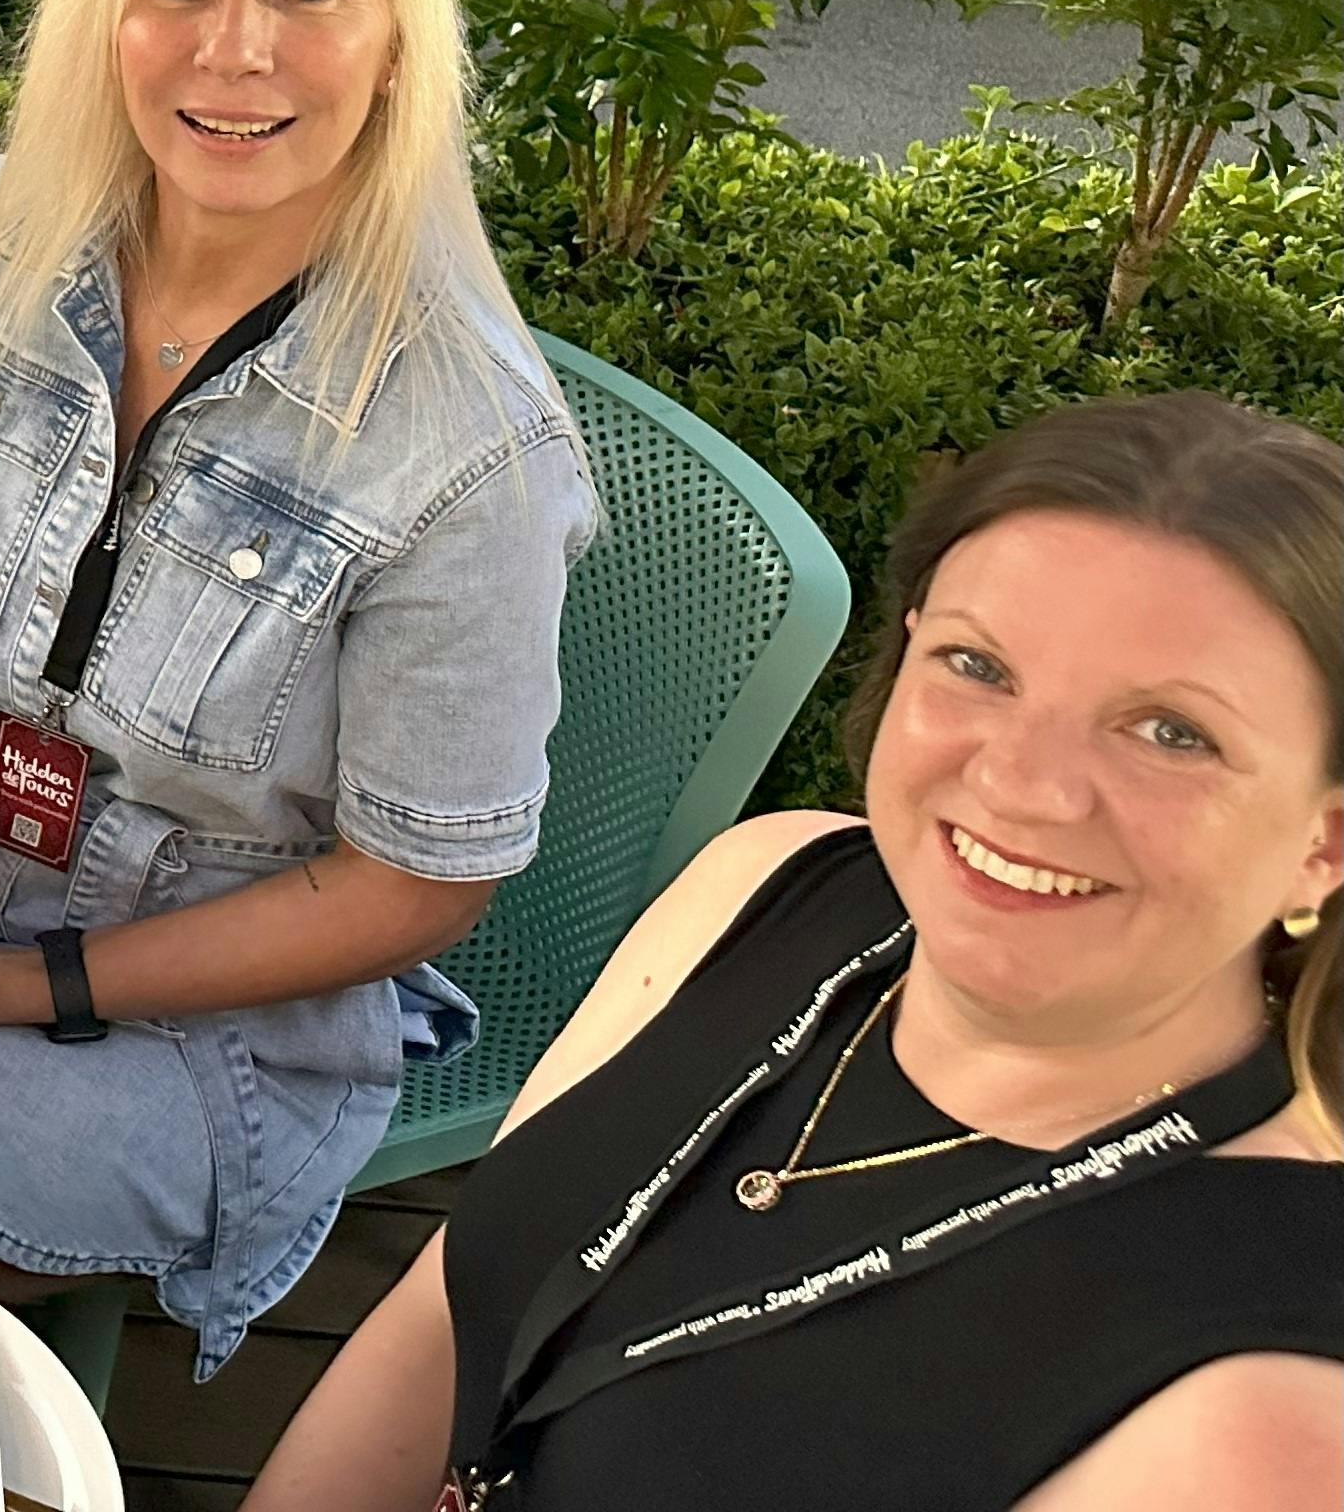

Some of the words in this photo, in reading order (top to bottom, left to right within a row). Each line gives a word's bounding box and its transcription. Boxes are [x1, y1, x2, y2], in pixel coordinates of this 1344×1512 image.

[2, 745, 75, 791] Hidden
[969, 1199, 1001, 1221] with
[902, 1208, 970, 1251] personality
[689, 1315, 717, 1335] with
